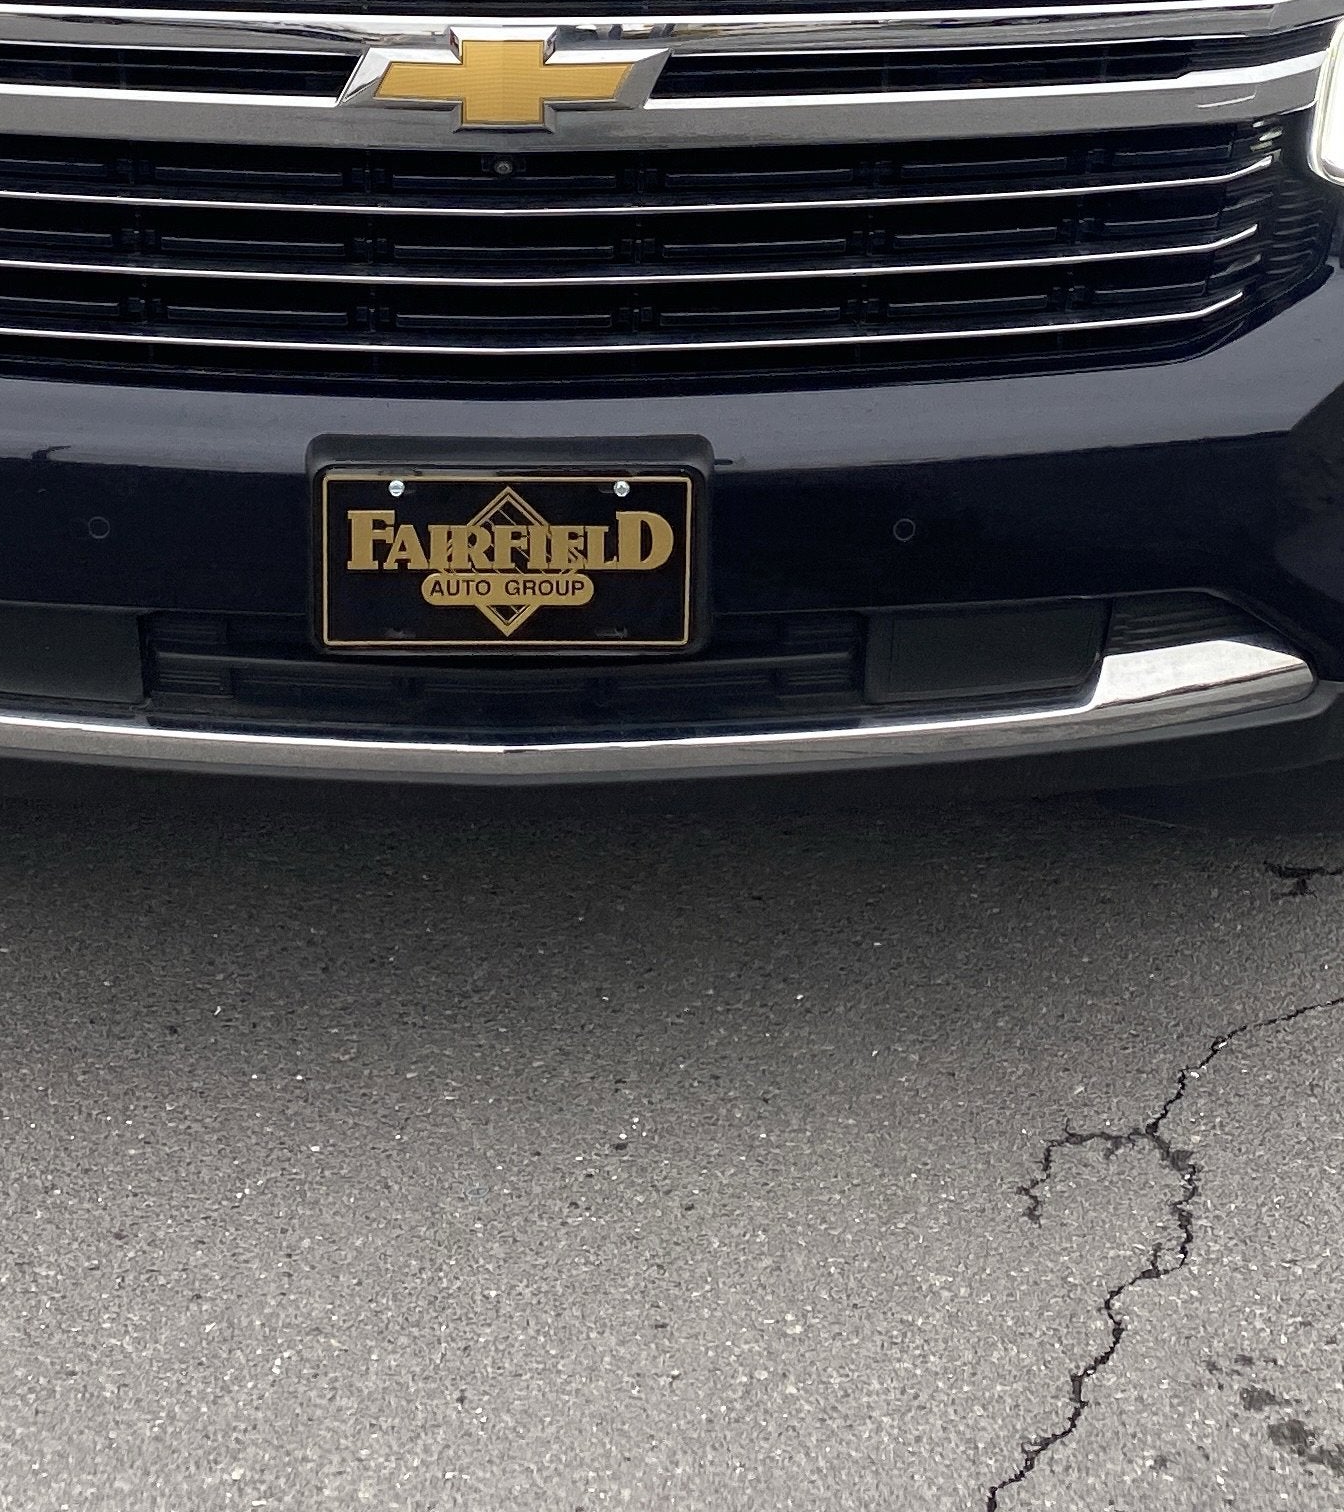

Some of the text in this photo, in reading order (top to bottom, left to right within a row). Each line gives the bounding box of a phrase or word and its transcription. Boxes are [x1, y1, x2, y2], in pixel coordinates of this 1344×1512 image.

[347, 509, 674, 571] FAIRFIELD
[429, 579, 586, 597] AUTO GROUP
